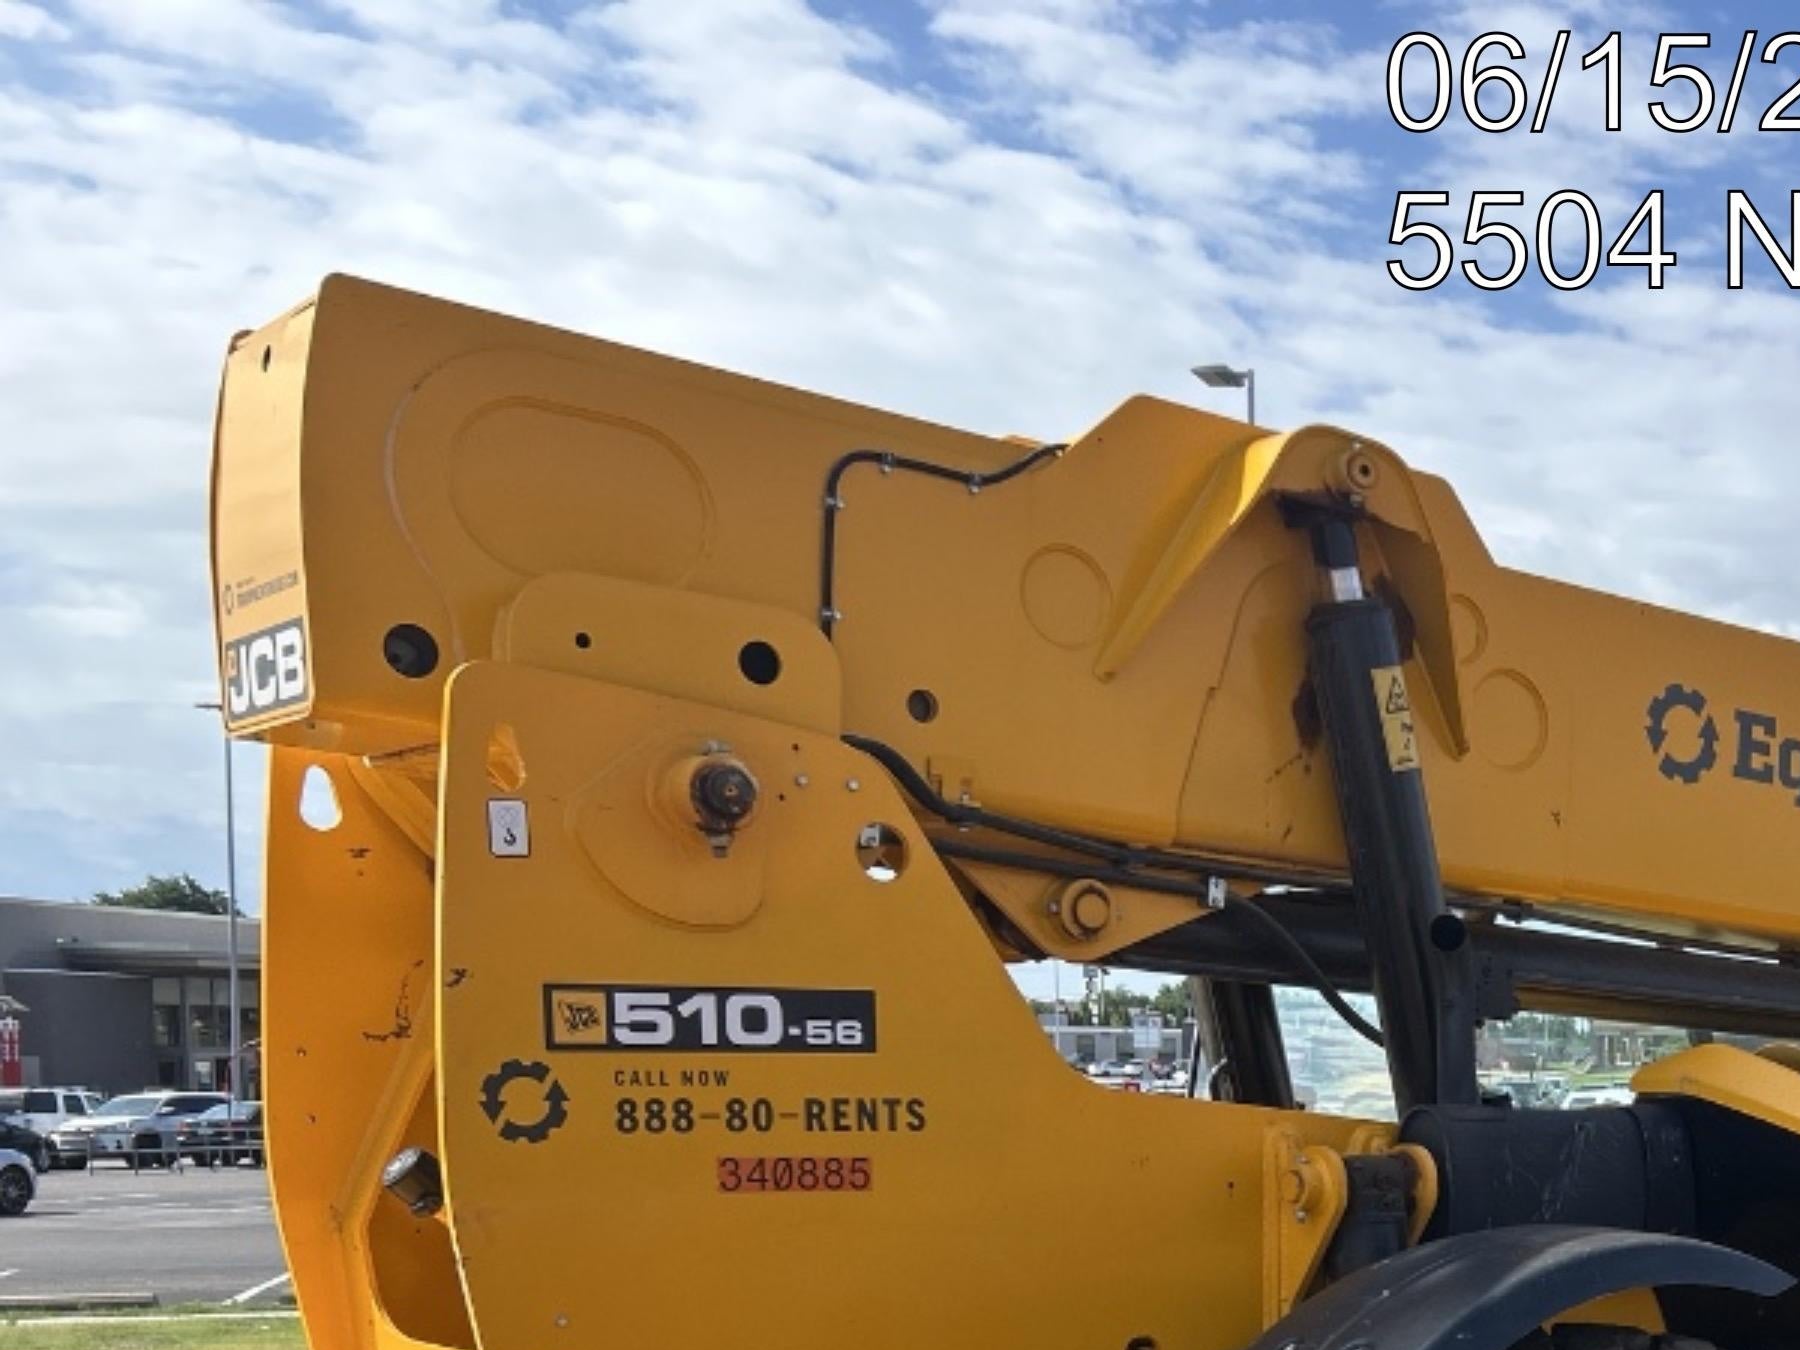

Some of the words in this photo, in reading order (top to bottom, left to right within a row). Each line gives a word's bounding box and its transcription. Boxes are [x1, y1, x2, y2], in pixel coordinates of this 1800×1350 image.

[230, 627, 304, 714] JCB
[614, 1069, 670, 1088] CALL
[681, 1069, 730, 1087] NOW
[615, 1097, 927, 1133] 888-80-RENTS
[718, 1156, 872, 1192] 340885
